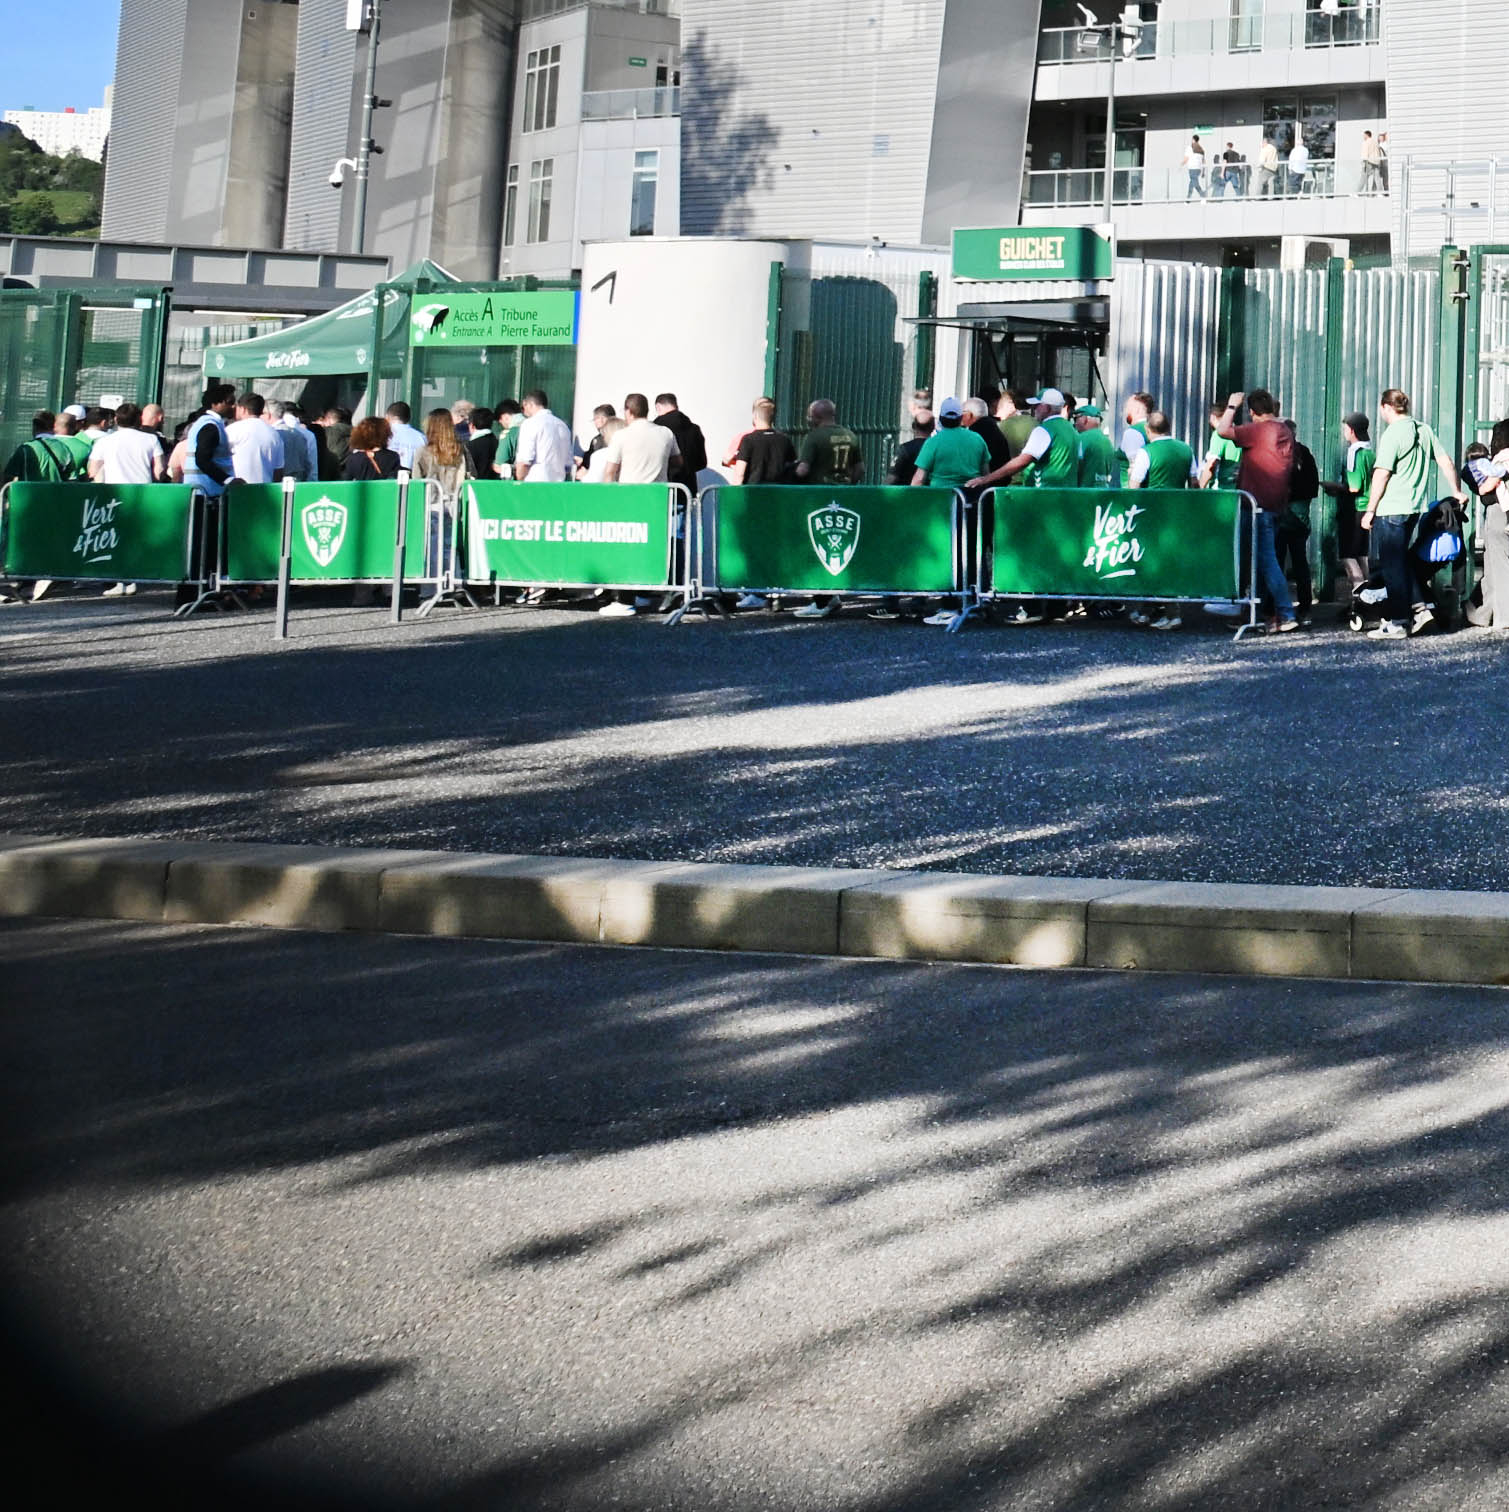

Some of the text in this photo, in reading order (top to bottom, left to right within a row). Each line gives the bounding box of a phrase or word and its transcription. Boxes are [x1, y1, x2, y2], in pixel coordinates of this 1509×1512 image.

[1000, 236, 1065, 260] GUICHET
[454, 297, 494, 322] Accès A
[501, 308, 538, 321] Tribune
[452, 326, 493, 337] Entrance A
[501, 324, 571, 337] Pierre Faurand
[833, 445, 851, 469] 17
[82, 496, 123, 529] Vert
[308, 508, 342, 525] ASSE
[815, 515, 855, 531] ASSE
[1093, 502, 1146, 540] Vert
[545, 520, 564, 541] LE
[566, 521, 648, 543] CHAUDRON
